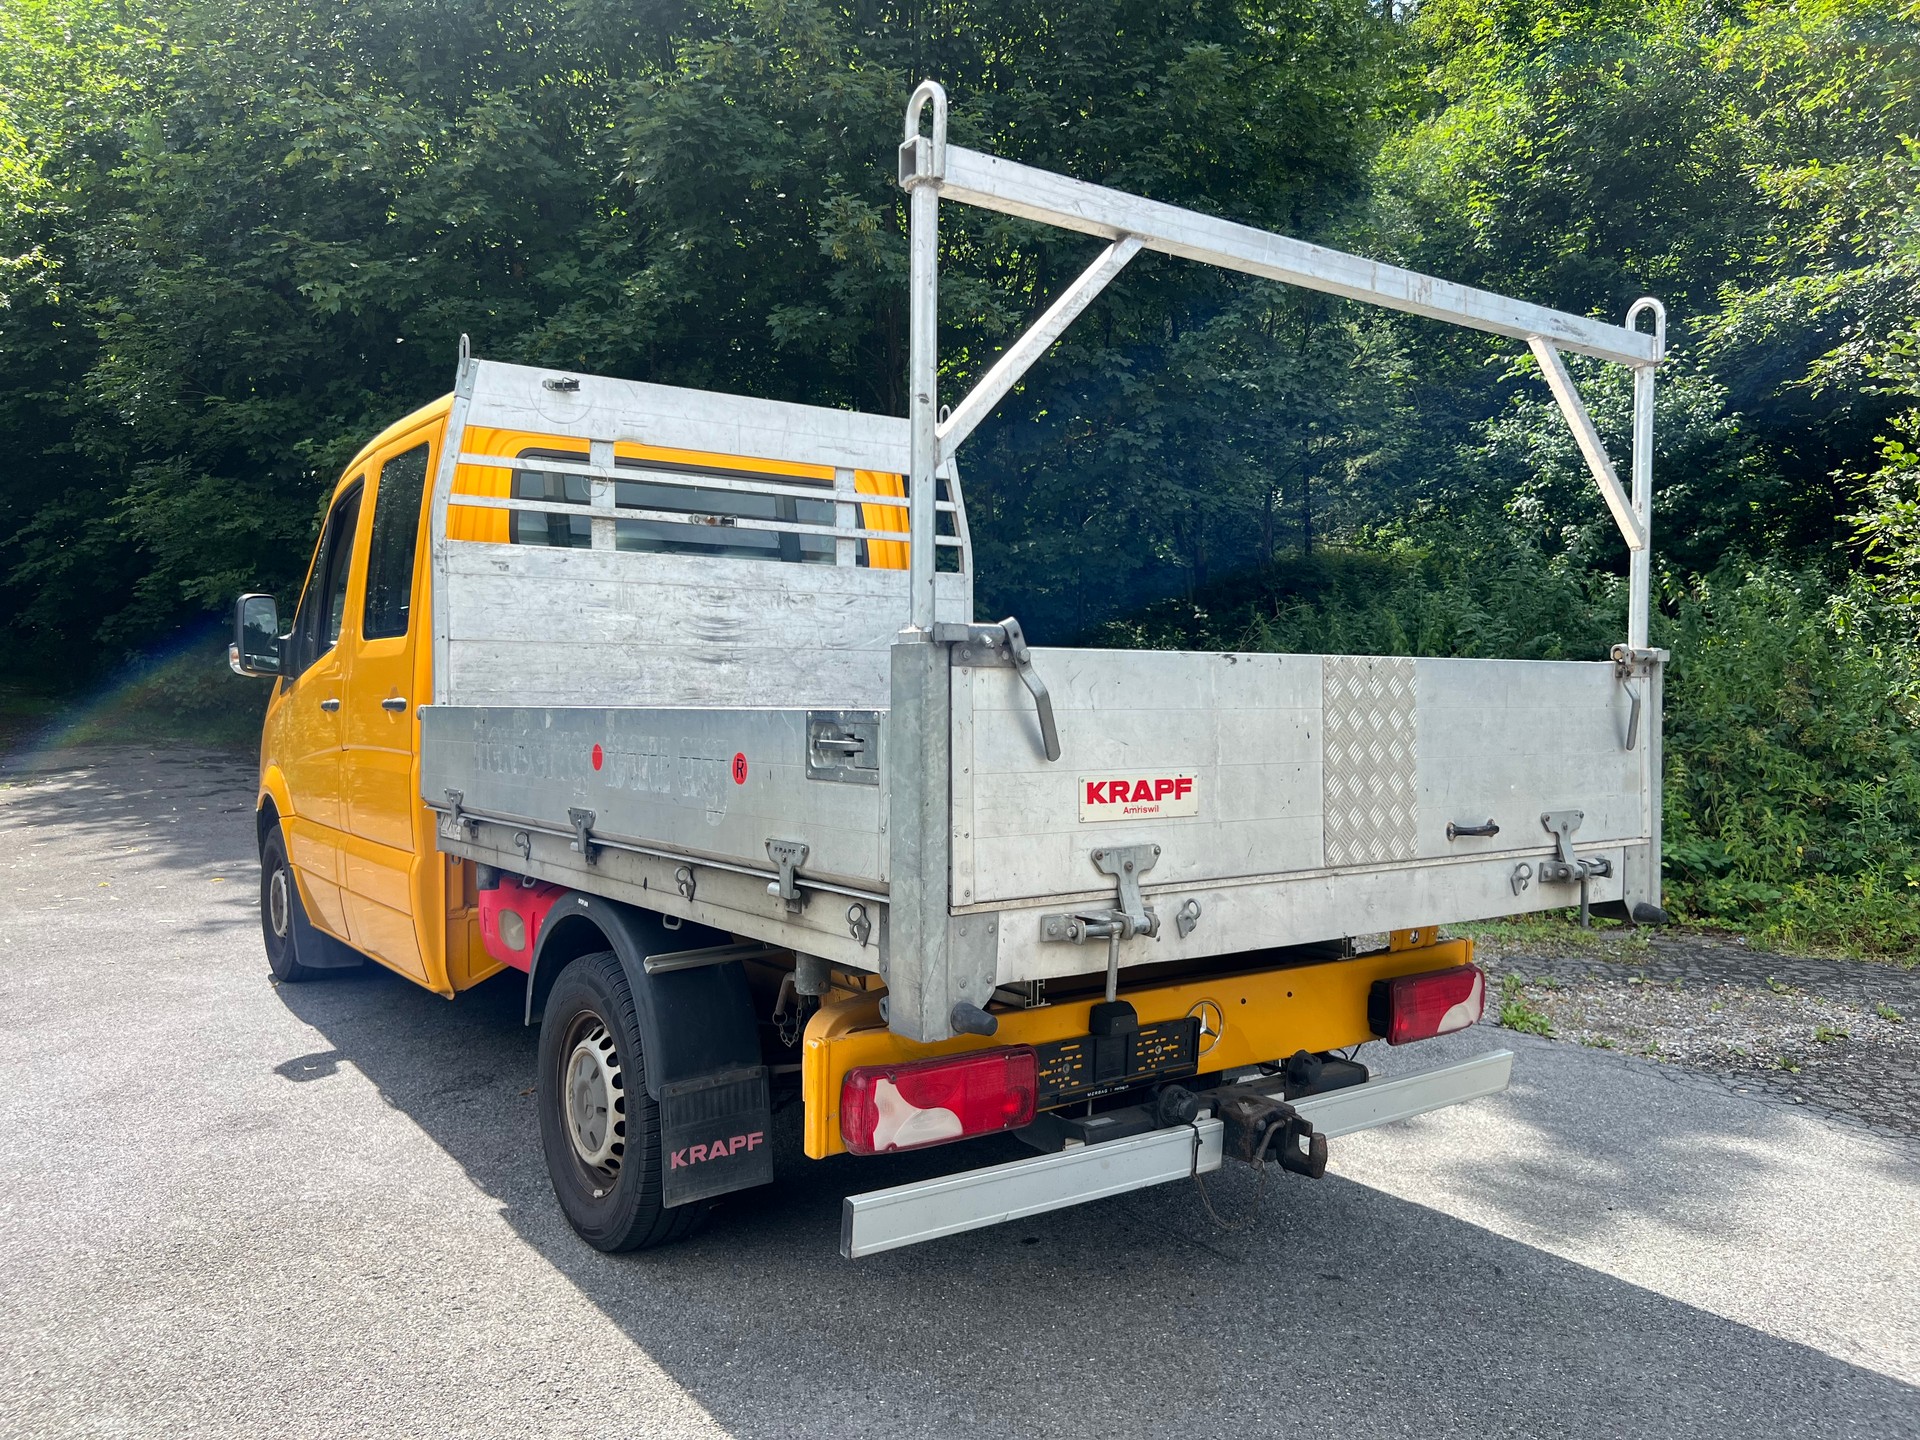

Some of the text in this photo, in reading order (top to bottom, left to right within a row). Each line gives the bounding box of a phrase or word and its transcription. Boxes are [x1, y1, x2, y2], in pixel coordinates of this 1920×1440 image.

[1086, 778, 1193, 804] KRAPF
[1123, 804, 1160, 815] Amriswil
[670, 1131, 764, 1170] KRAPF
